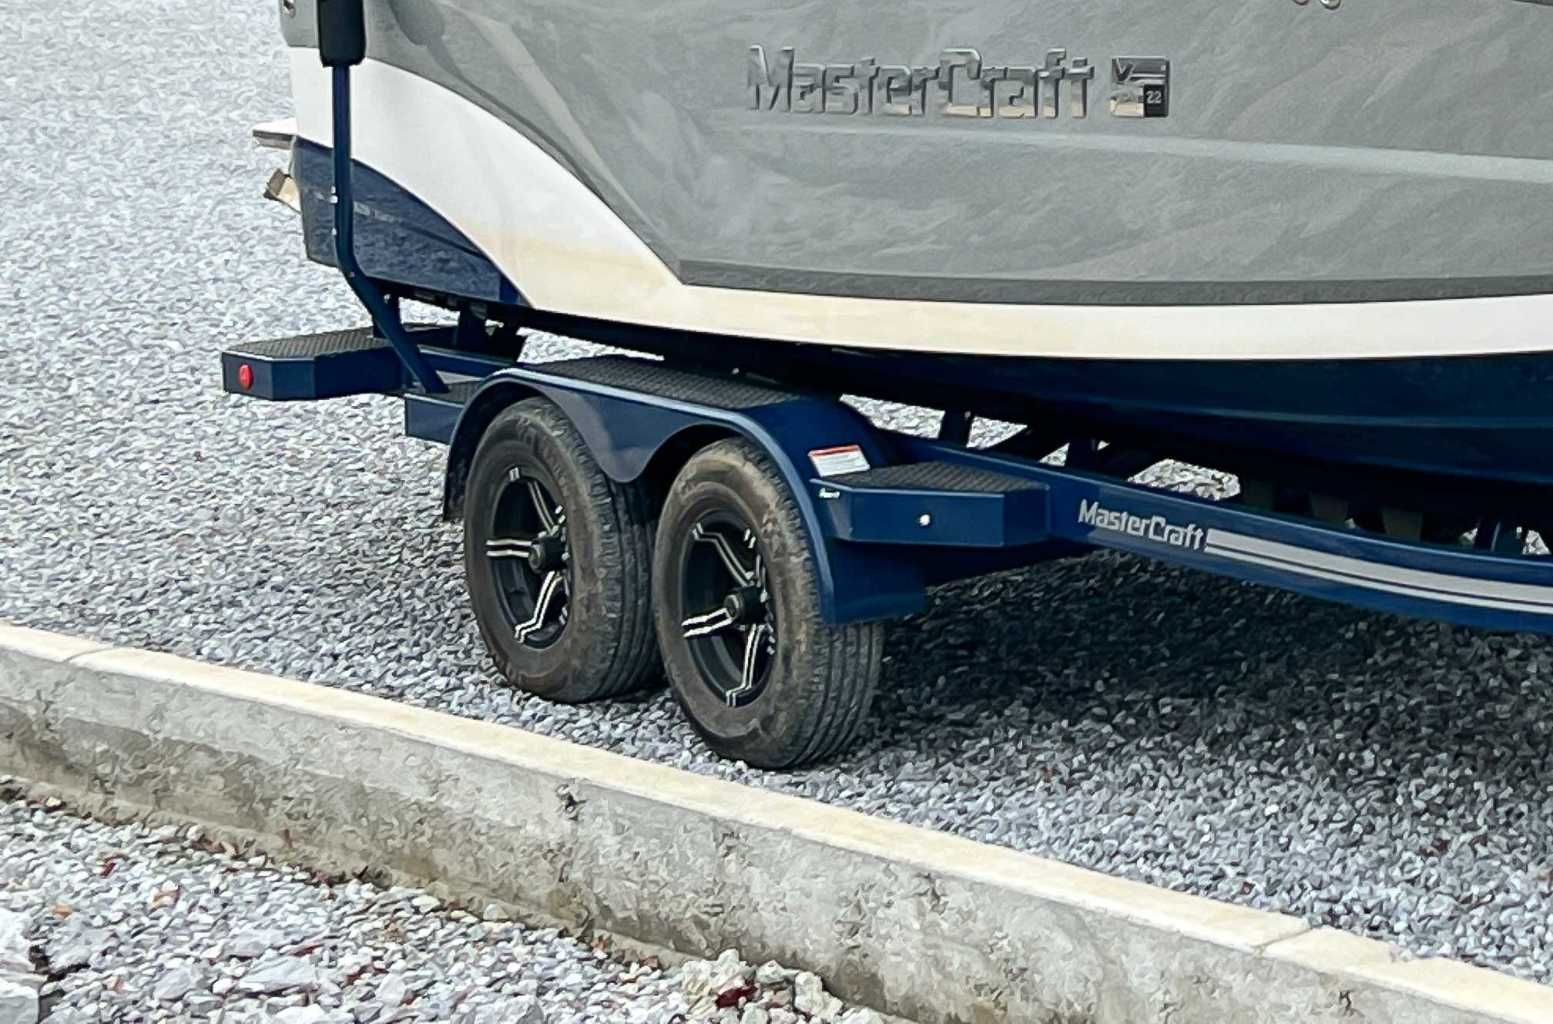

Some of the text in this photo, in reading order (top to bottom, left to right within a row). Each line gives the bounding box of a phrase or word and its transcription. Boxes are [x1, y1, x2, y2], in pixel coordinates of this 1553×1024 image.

[746, 44, 1096, 119] MasterCraft
[1145, 89, 1163, 105] 22
[1078, 499, 1204, 550] MasterCraft
